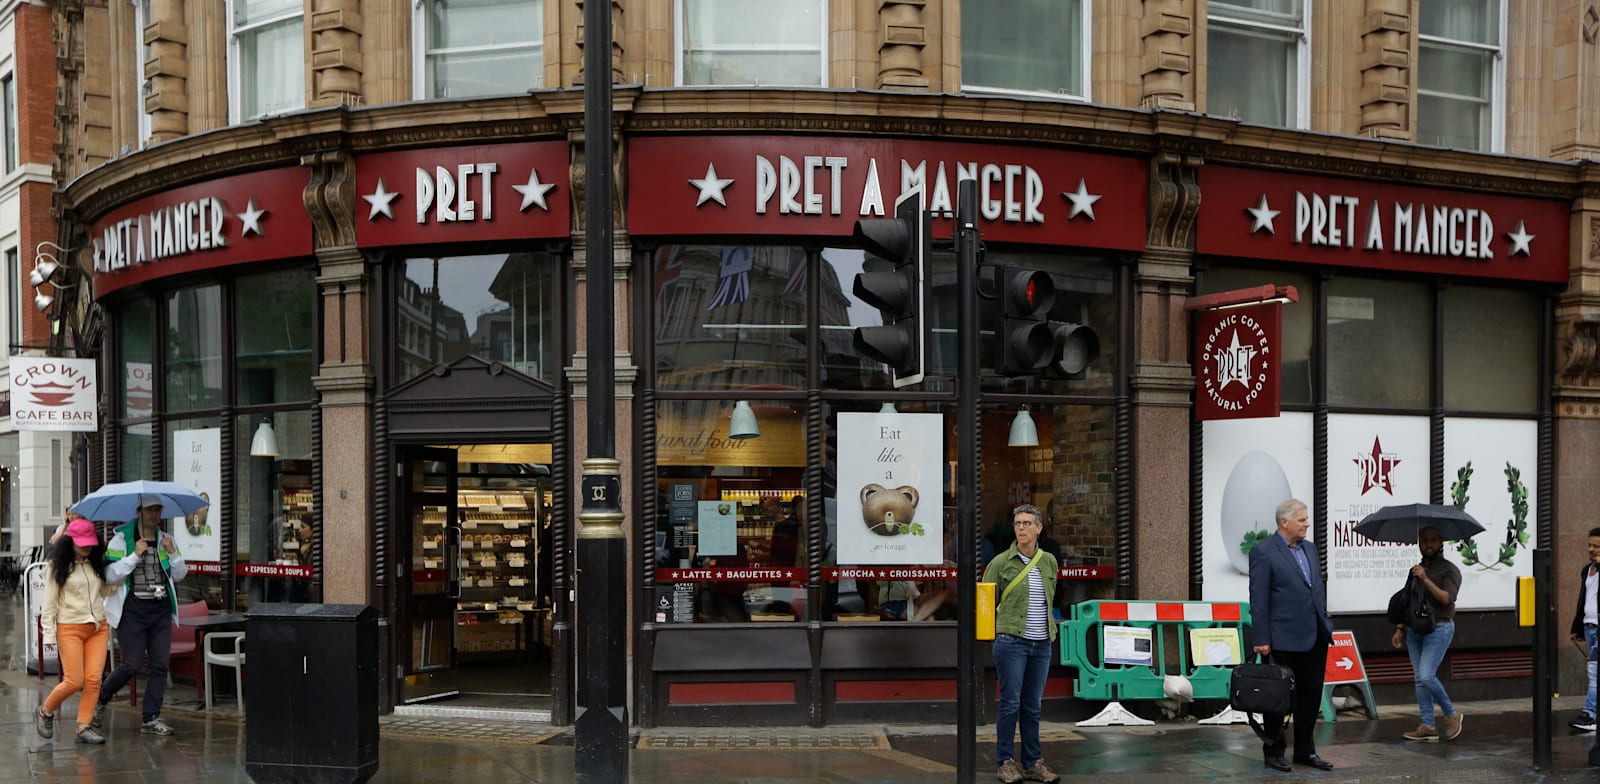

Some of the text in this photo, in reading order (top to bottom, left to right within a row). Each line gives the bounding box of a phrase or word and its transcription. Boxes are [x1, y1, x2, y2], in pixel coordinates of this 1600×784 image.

[416, 162, 497, 224] PRET
[756, 155, 848, 215] PRET
[859, 158, 885, 216] A
[104, 196, 225, 272] PRET A MANGER
[1294, 190, 1494, 260] PRET A MANGER
[1203, 314, 1269, 361] ORGANIC COFFEE
[1217, 345, 1254, 383] PRET
[14, 363, 92, 389] CROWN
[1205, 373, 1266, 411] NATURAL FOOD
[15, 410, 93, 420] CAFE BAR
[879, 426, 902, 440] Eat
[192, 441, 203, 453] Eat
[877, 447, 903, 463] like
[885, 470, 893, 480] a
[1357, 452, 1397, 488] PRET
[250, 565, 303, 576] ESPRESSO SOUPS
[682, 570, 782, 579] LATTE BAGUETTES
[889, 570, 947, 578] CROISSANTS
[1061, 568, 1088, 577] WHITE
